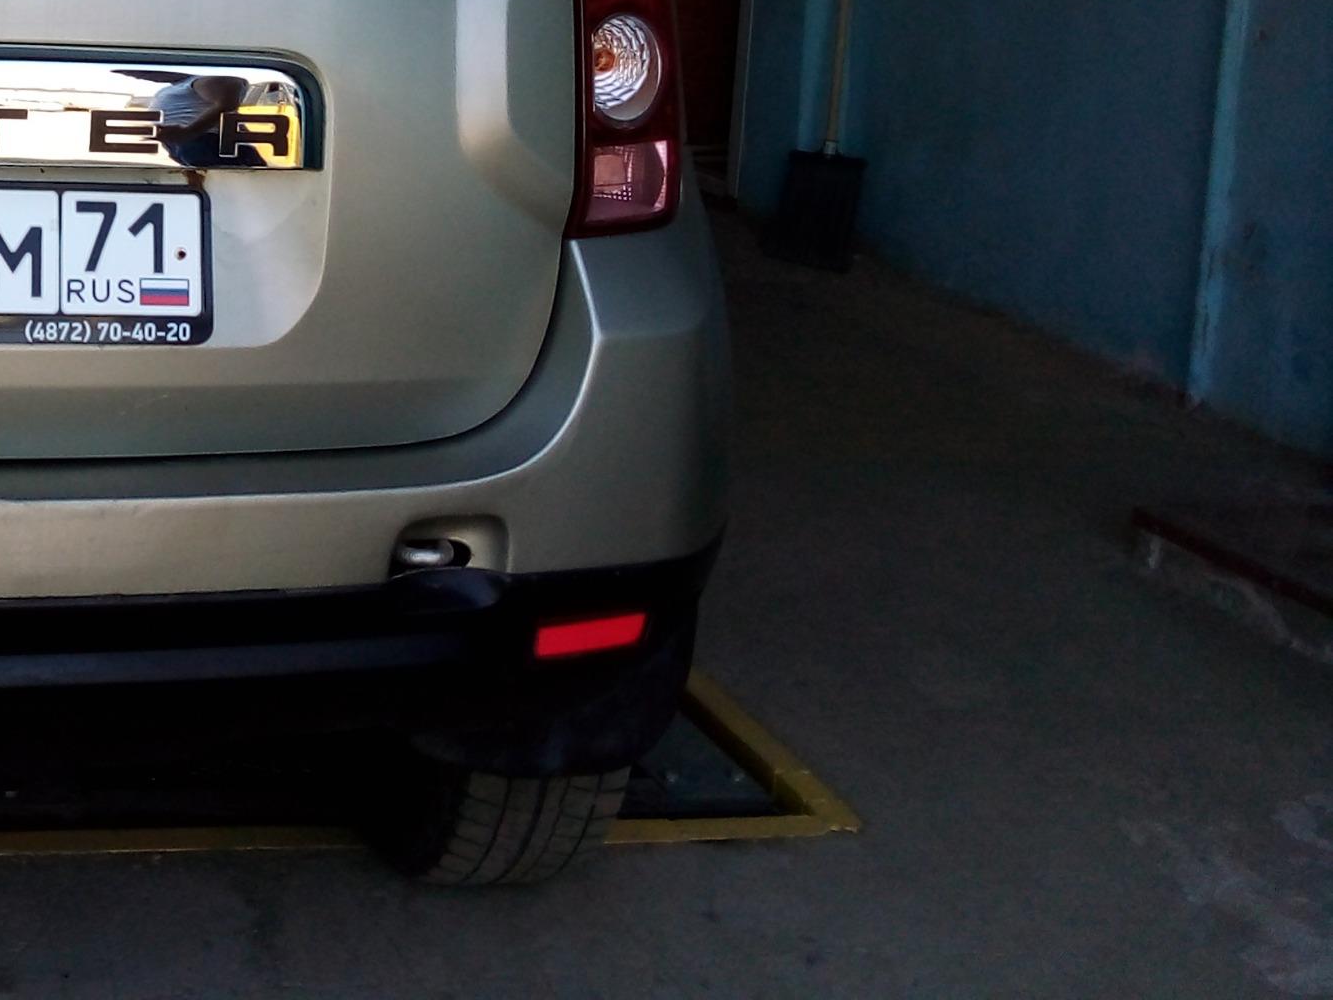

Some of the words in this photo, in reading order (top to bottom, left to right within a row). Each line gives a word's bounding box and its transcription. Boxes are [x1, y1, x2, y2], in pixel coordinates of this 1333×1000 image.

[75, 200, 164, 274] 71
[67, 279, 135, 303] RUS
[25, 320, 91, 343] (4872)
[97, 322, 191, 342] 70-40-20
